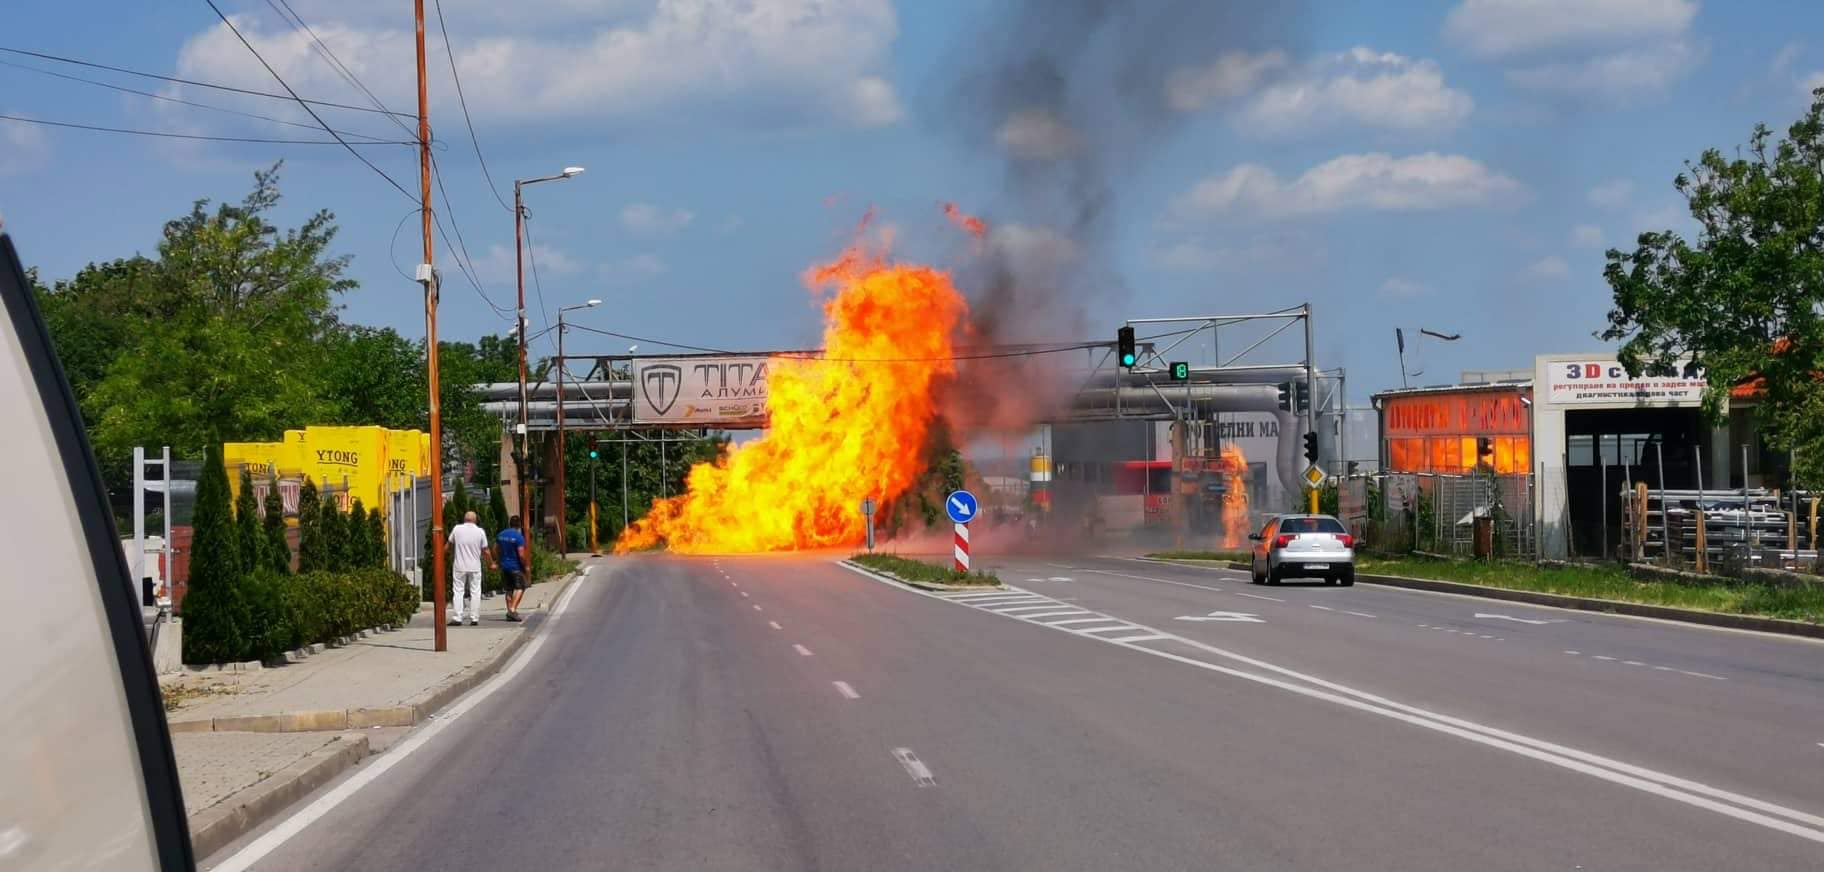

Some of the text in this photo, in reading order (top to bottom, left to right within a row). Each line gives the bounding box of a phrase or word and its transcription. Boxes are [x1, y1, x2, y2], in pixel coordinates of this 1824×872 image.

[694, 362, 768, 387] TITA
[1566, 363, 1601, 379] 3D
[701, 387, 768, 397] АЛУМИ
[1553, 383, 1604, 391] регулиране
[316, 450, 359, 465] YTONG
